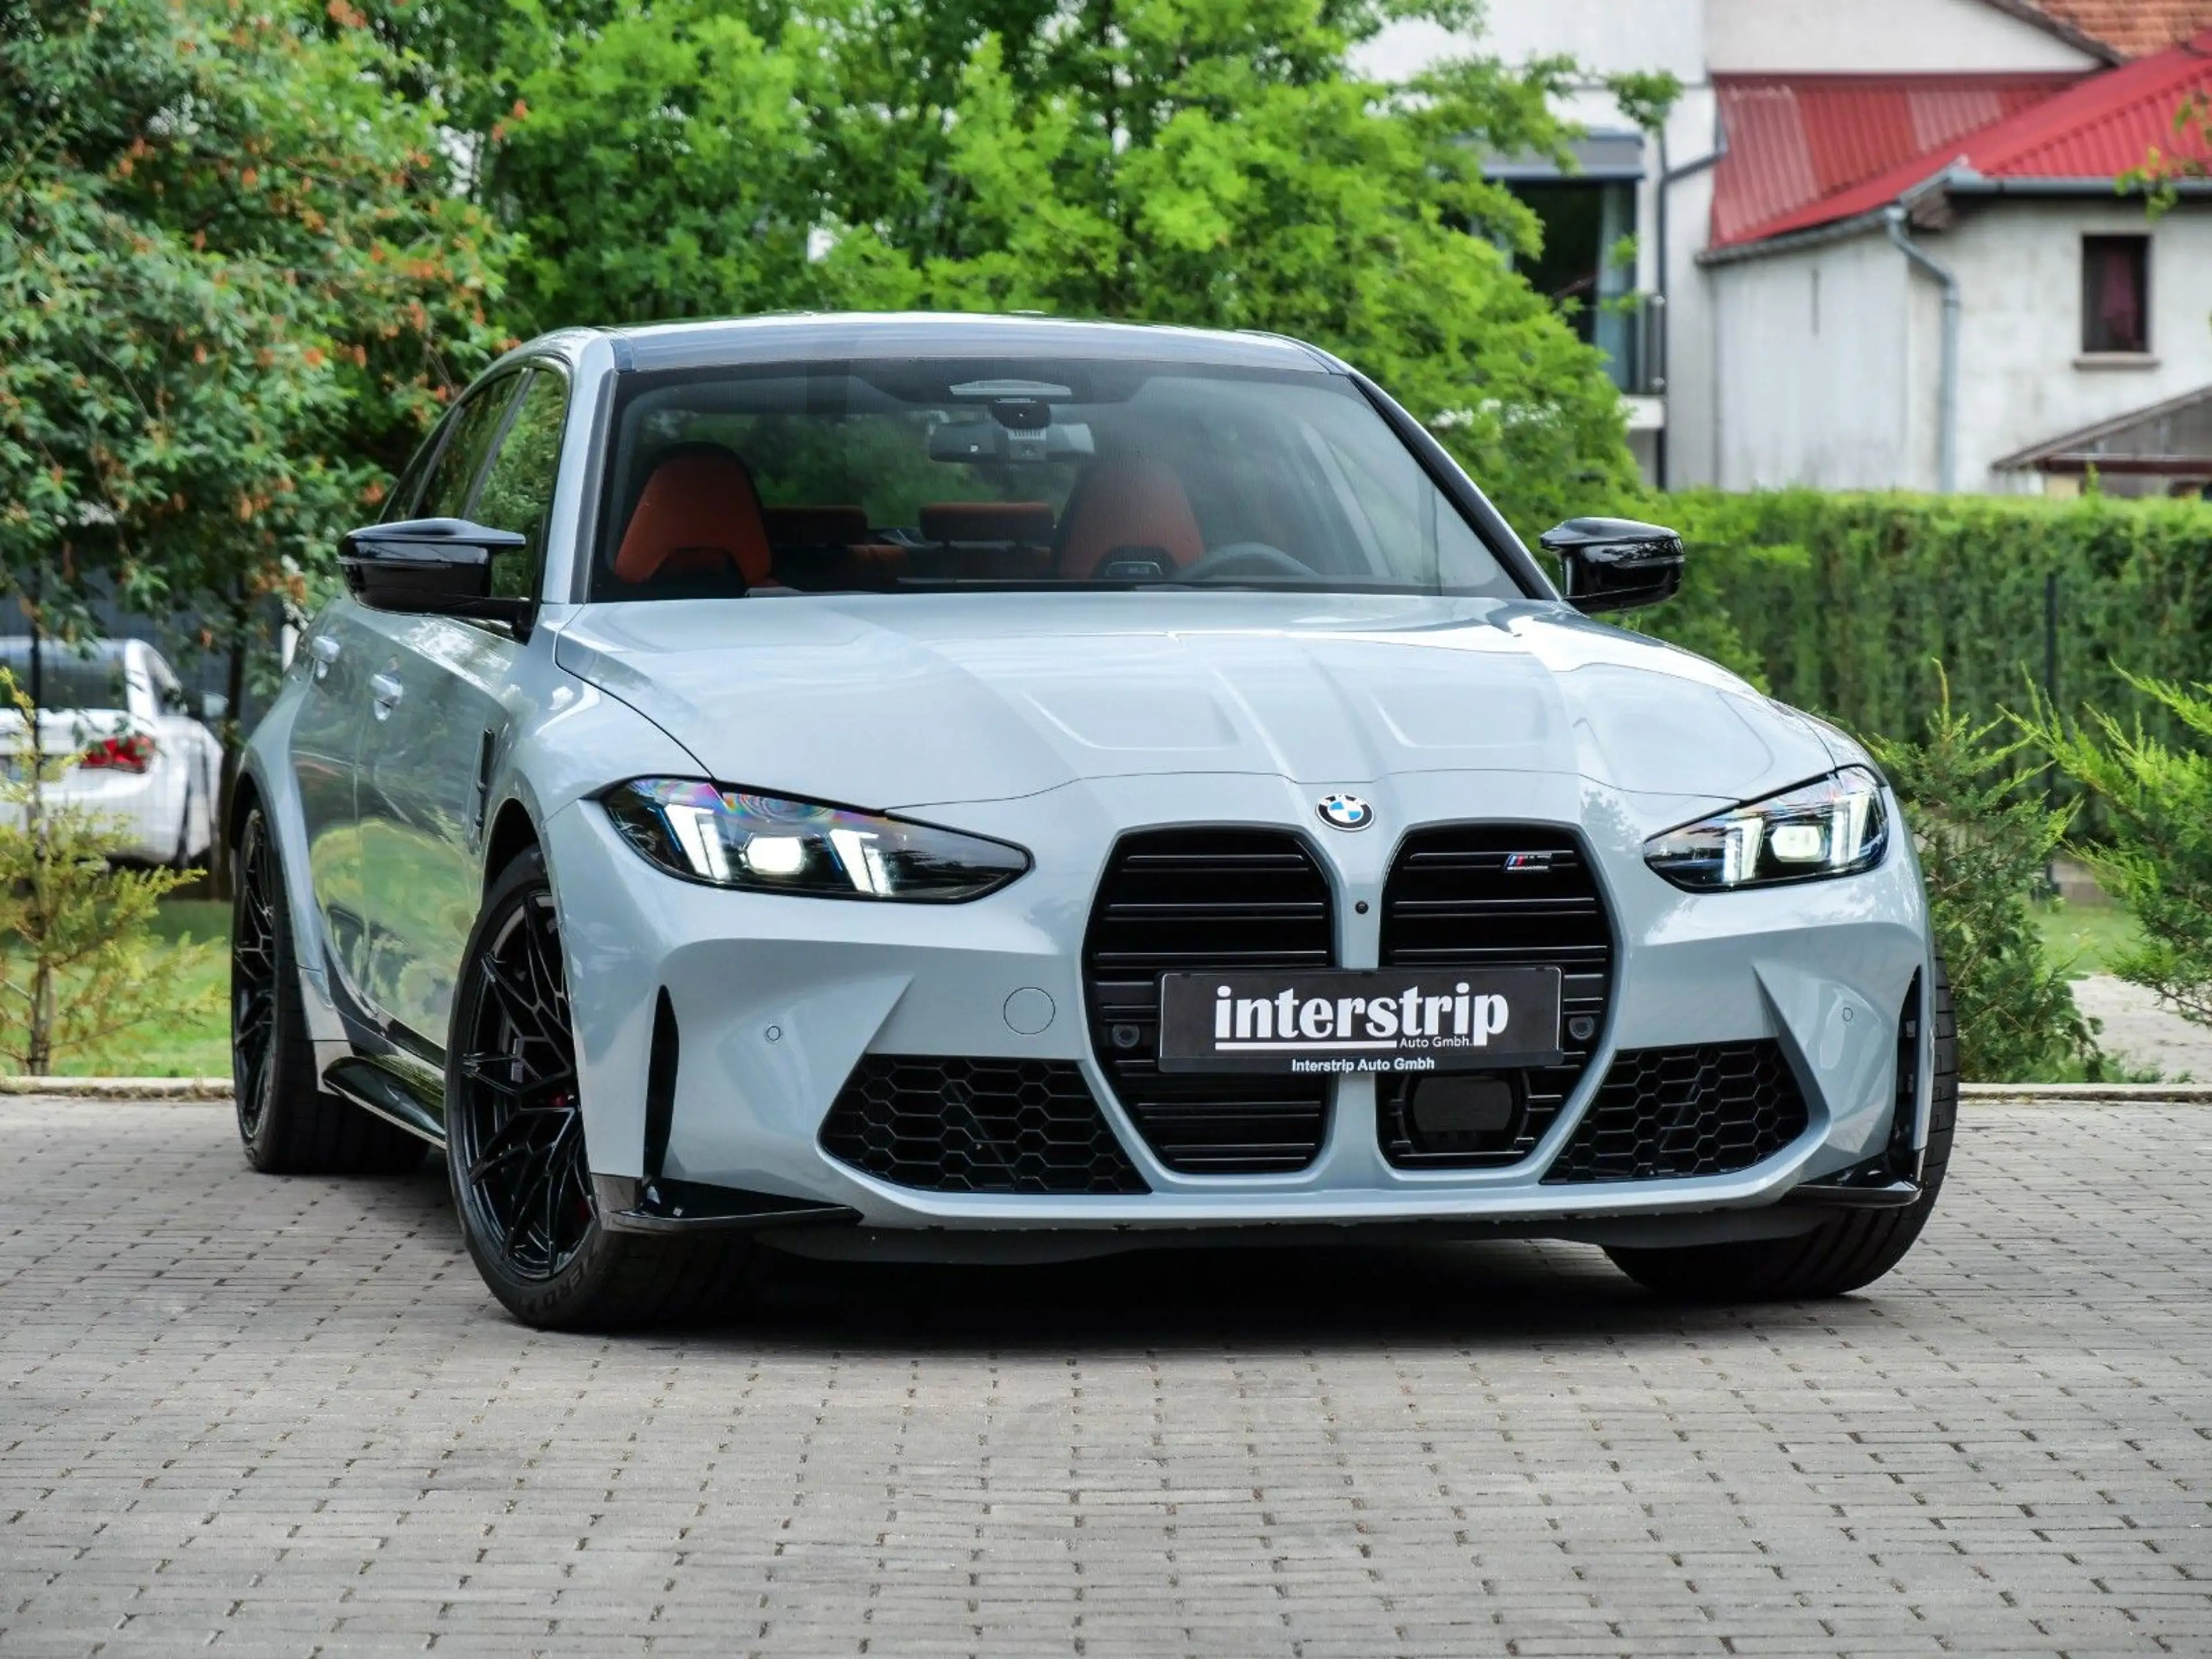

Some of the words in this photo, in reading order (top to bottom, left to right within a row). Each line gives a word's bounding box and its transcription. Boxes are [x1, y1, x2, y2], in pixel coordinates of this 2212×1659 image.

[1215, 982, 1509, 1046] interstrip
[1400, 1037, 1429, 1048] Auto
[1292, 1058, 1354, 1074] Interstrip
[1357, 1058, 1391, 1071] Auto
[1393, 1056, 1435, 1070] Gmbh
